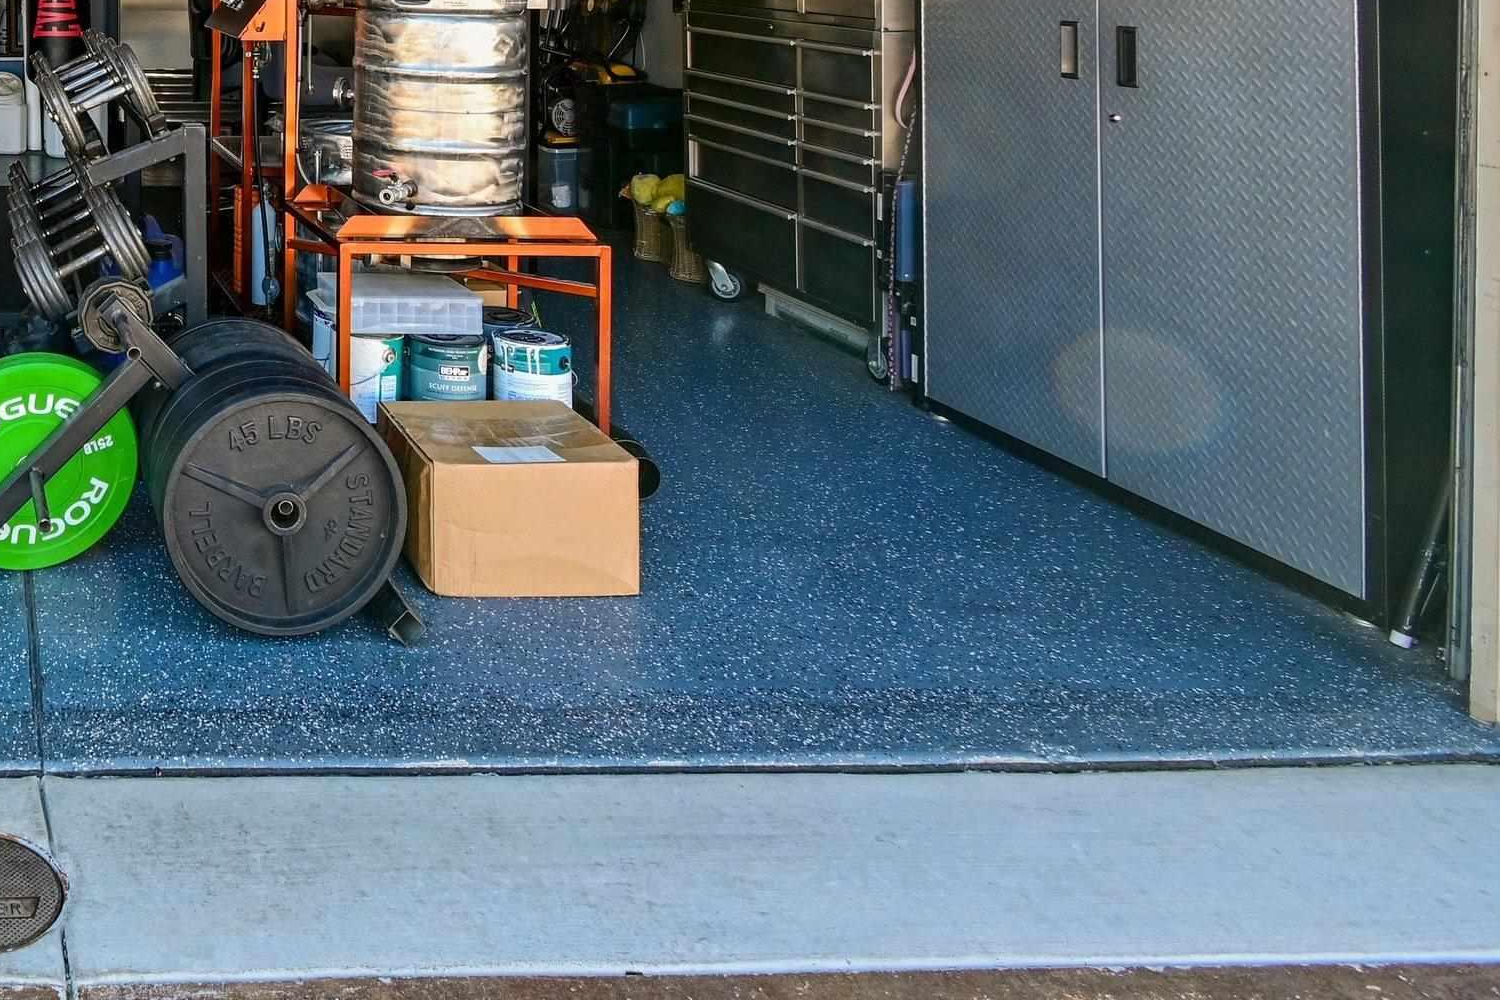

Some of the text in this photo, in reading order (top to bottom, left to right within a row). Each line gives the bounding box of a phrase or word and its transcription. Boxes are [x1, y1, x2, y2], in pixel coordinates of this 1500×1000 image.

[228, 415, 323, 452] 45 LBS
[189, 501, 268, 598] BARBELL
[304, 472, 373, 594] STANDARD
